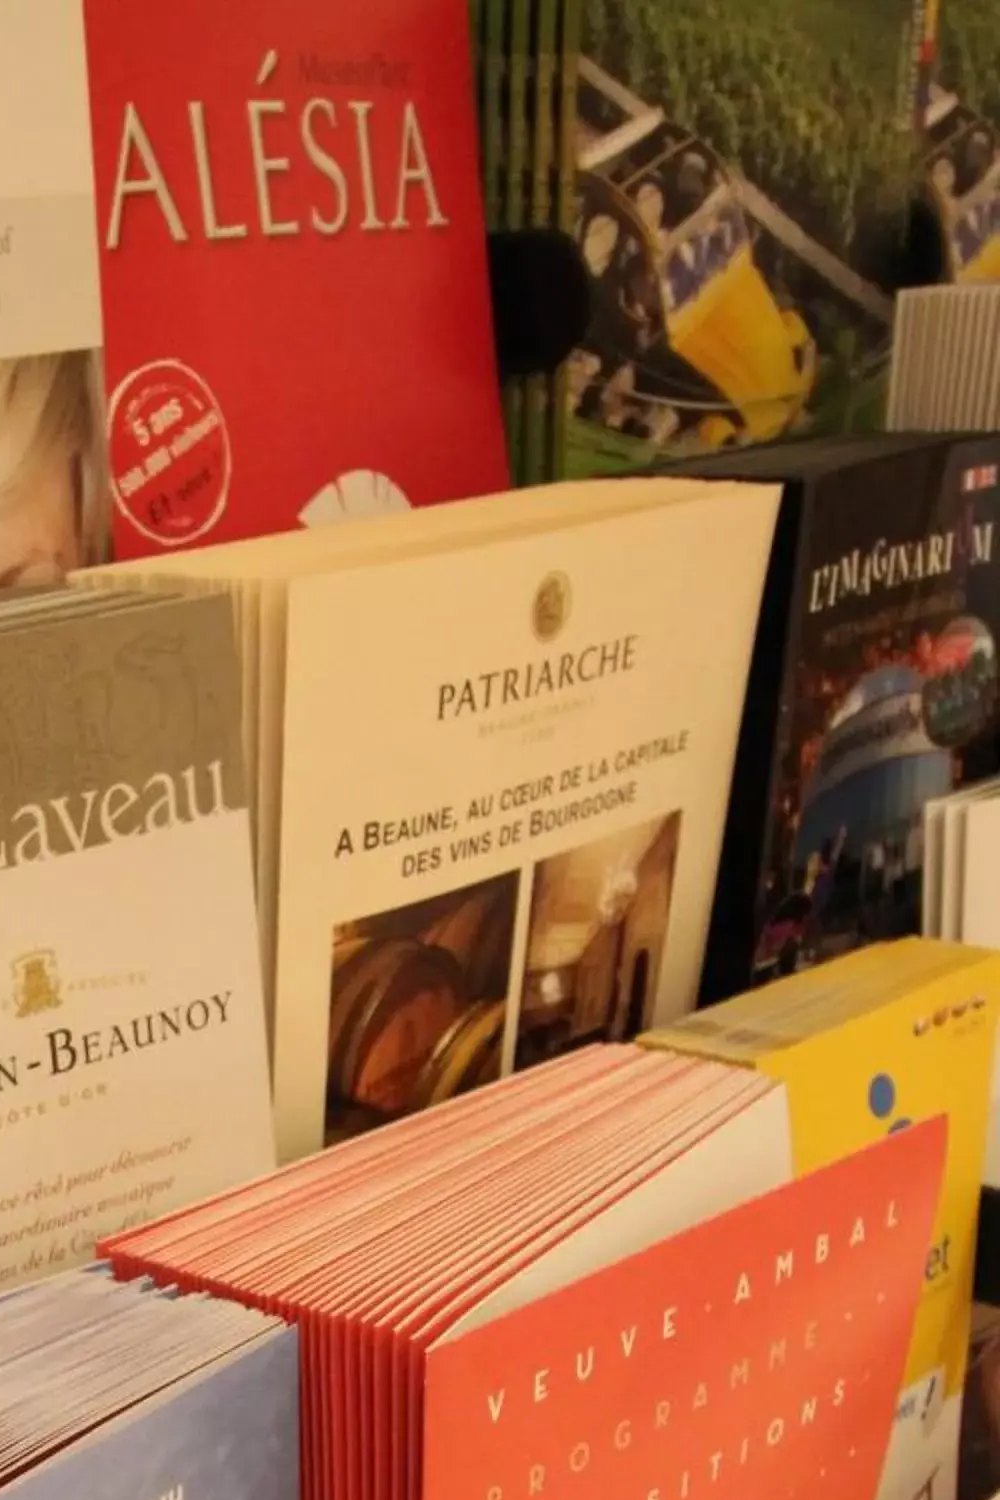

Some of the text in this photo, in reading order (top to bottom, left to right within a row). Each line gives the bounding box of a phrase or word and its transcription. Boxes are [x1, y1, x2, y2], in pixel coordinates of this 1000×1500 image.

[105, 49, 449, 250] ALÉSIA
[436, 633, 641, 722] PATRIARCHE
[334, 728, 691, 860] A BEAUNE, AU CŒUR DE LA CAPITALE
[400, 780, 640, 879] DES VINS DE BOURGOGNE
[487, 1199, 900, 1424] VEUVE AMBAL
